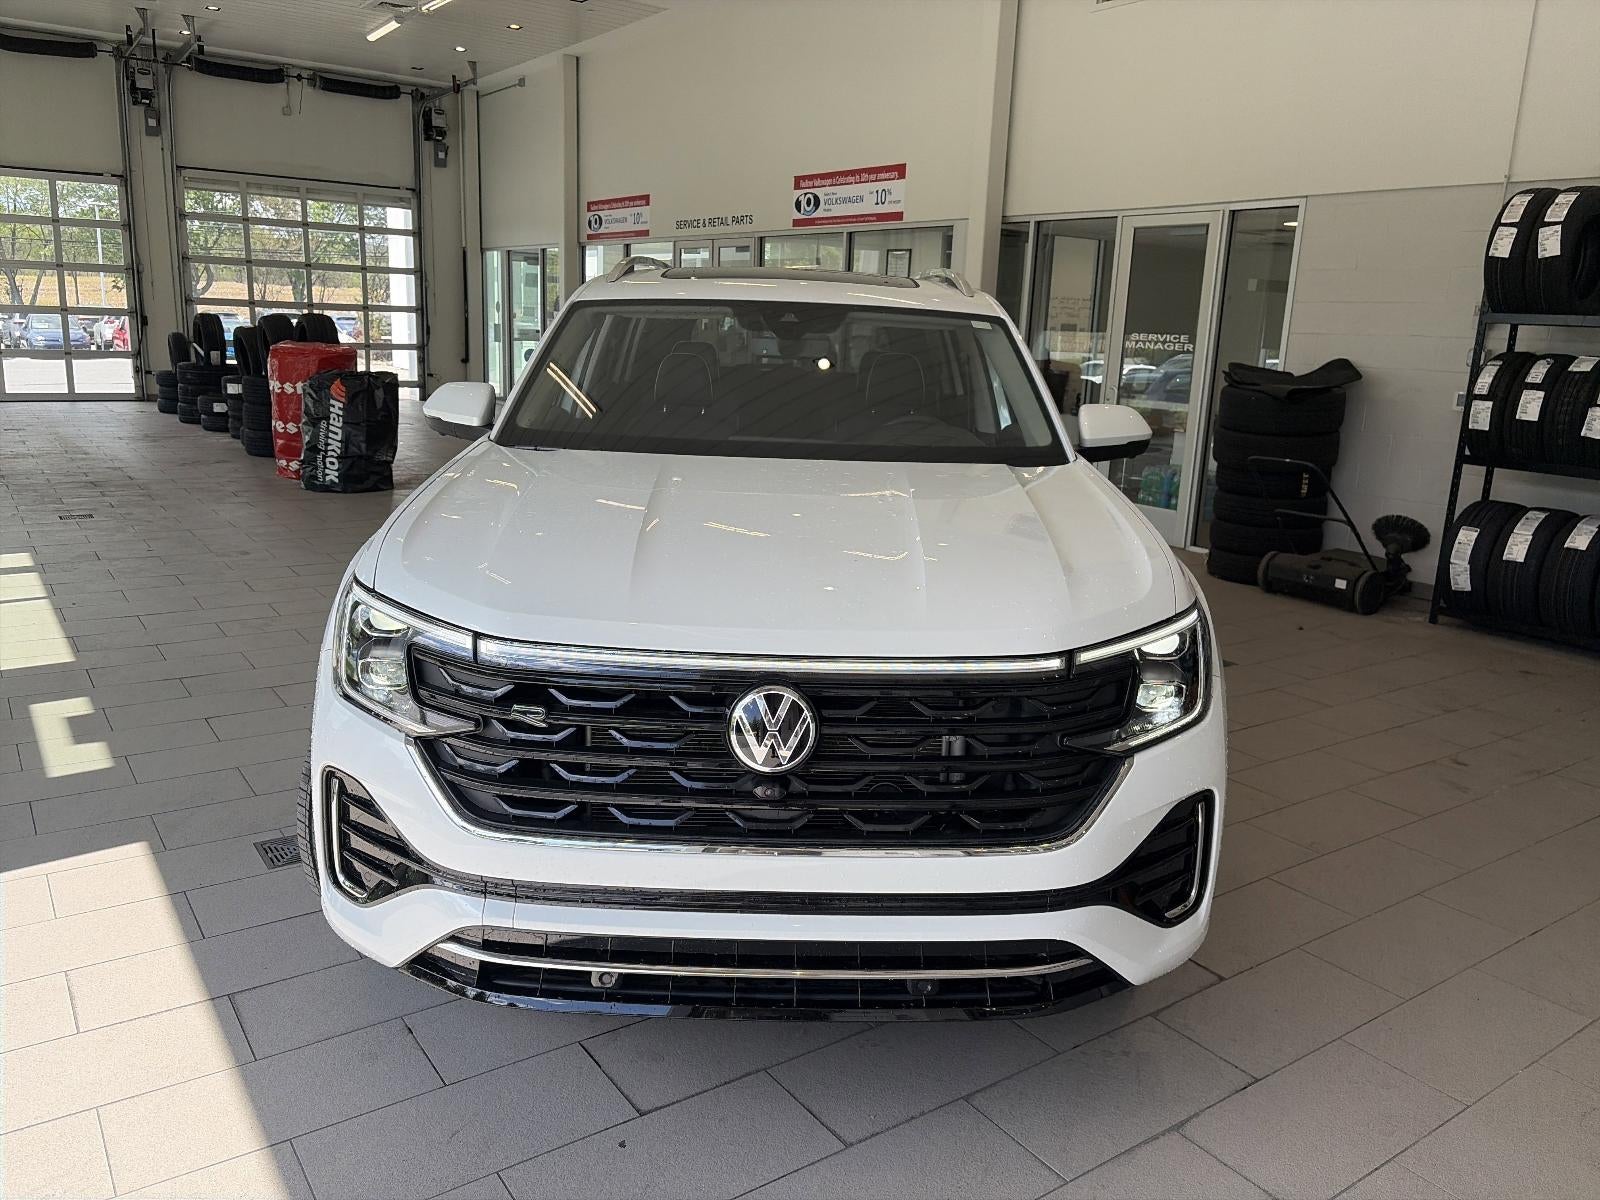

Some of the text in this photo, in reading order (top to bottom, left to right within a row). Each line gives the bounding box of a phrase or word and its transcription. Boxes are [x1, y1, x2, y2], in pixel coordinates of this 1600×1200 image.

[823, 194, 864, 207] VOLKSWAGEN
[675, 214, 754, 230] SERVICE & RETAIL PARTS
[1130, 333, 1190, 343] SERVICE
[1125, 341, 1195, 352] MANAGER
